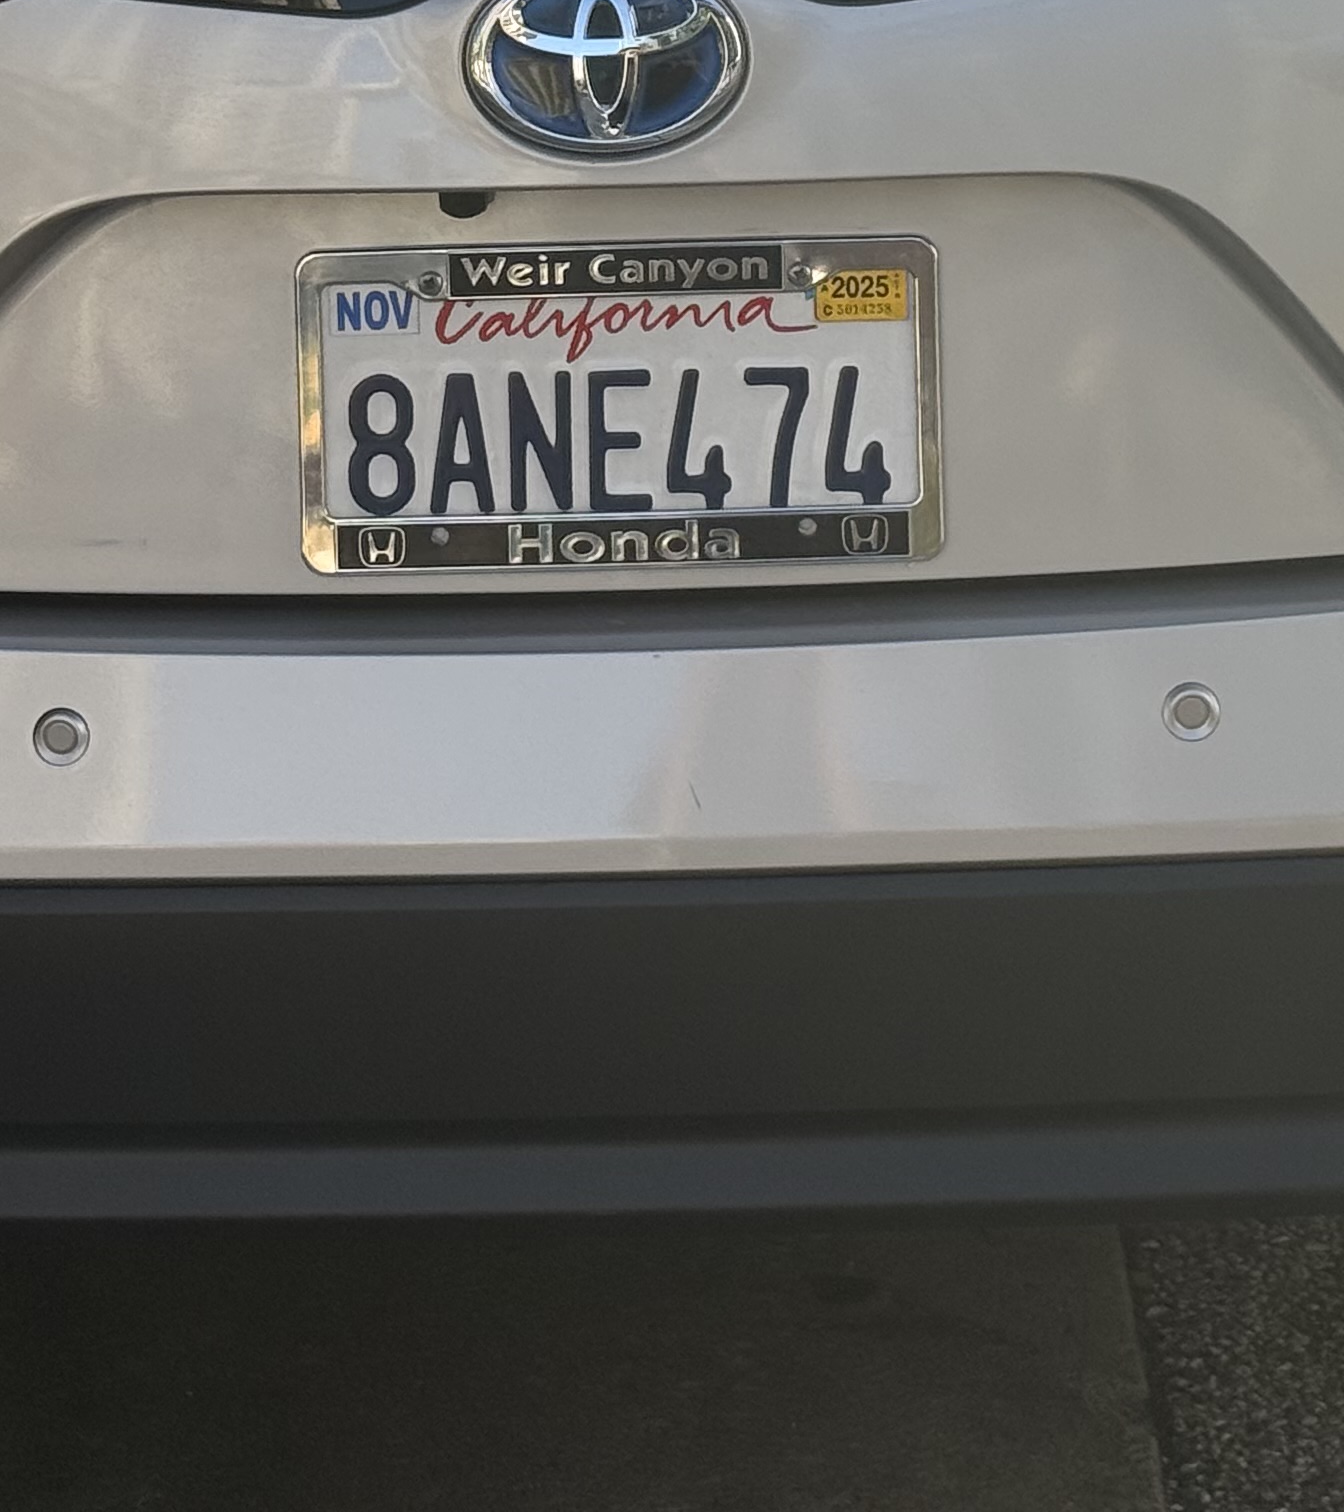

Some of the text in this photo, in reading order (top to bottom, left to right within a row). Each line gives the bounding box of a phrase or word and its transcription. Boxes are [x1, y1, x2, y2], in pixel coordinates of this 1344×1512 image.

[460, 252, 770, 290] Weir Canyon
[831, 275, 890, 299] 2025
[336, 291, 413, 332] NOV
[434, 294, 818, 362] California
[347, 365, 892, 517] 8ANE474
[507, 519, 741, 564] Honda
